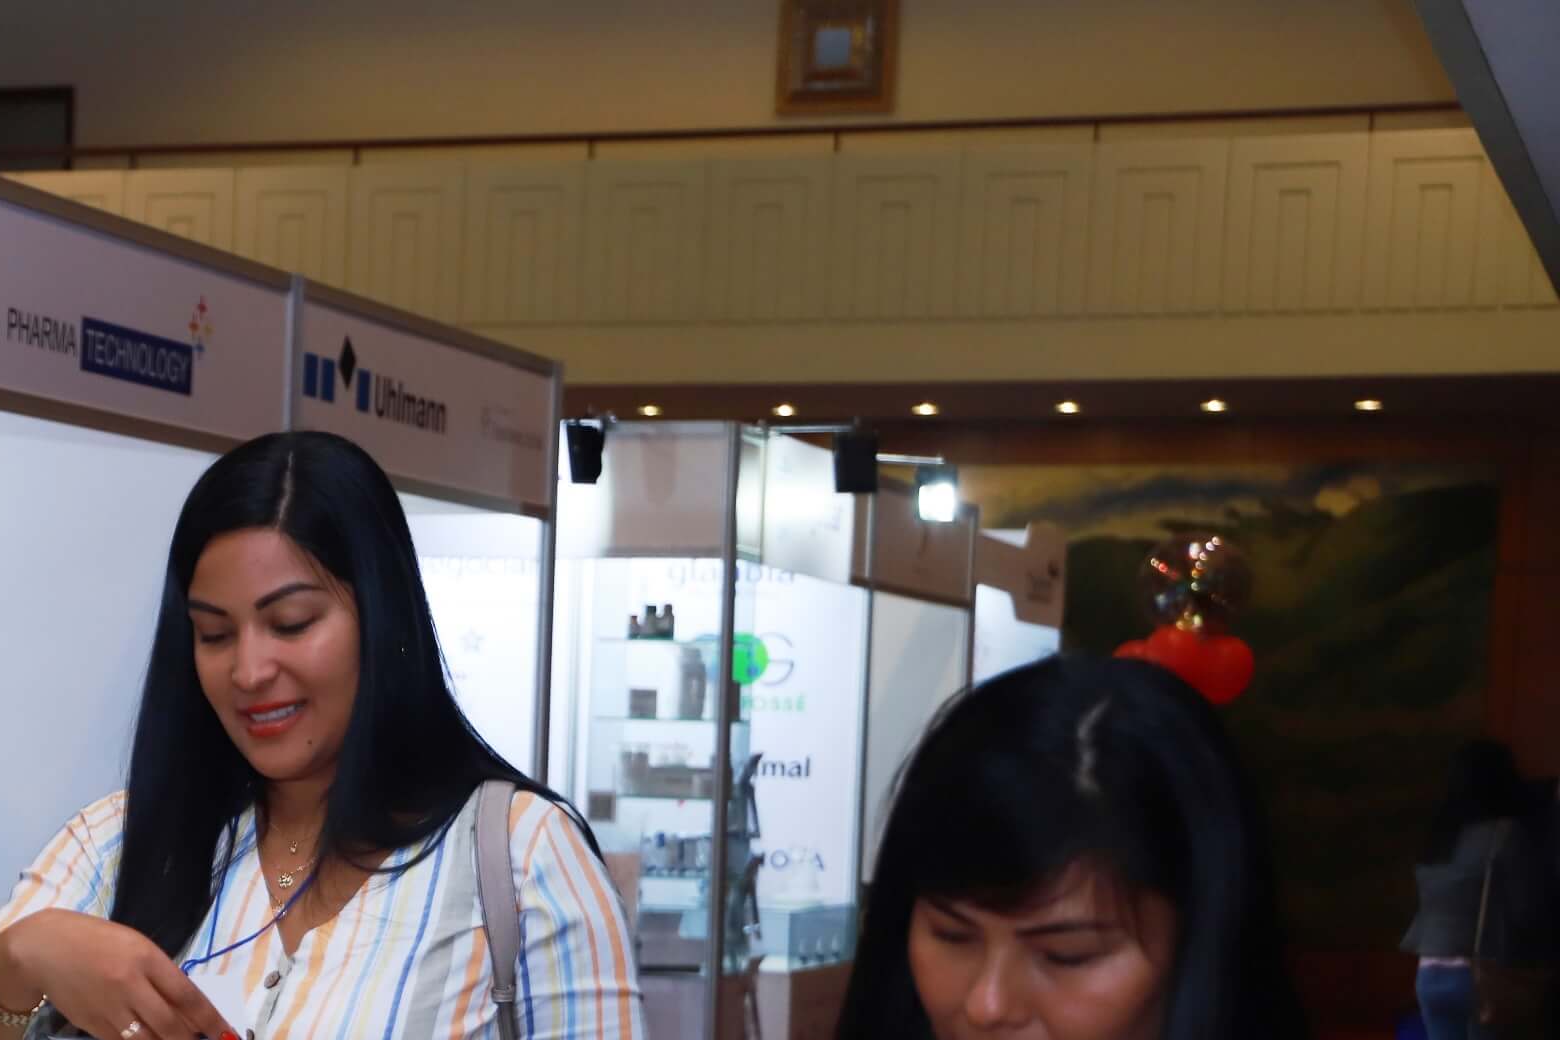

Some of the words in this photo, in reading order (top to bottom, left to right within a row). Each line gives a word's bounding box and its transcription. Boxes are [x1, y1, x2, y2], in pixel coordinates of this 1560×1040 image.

[7, 308, 78, 357] PHARMA
[85, 328, 191, 381] TECHNOLOGY
[375, 374, 447, 434] Uhlmann
